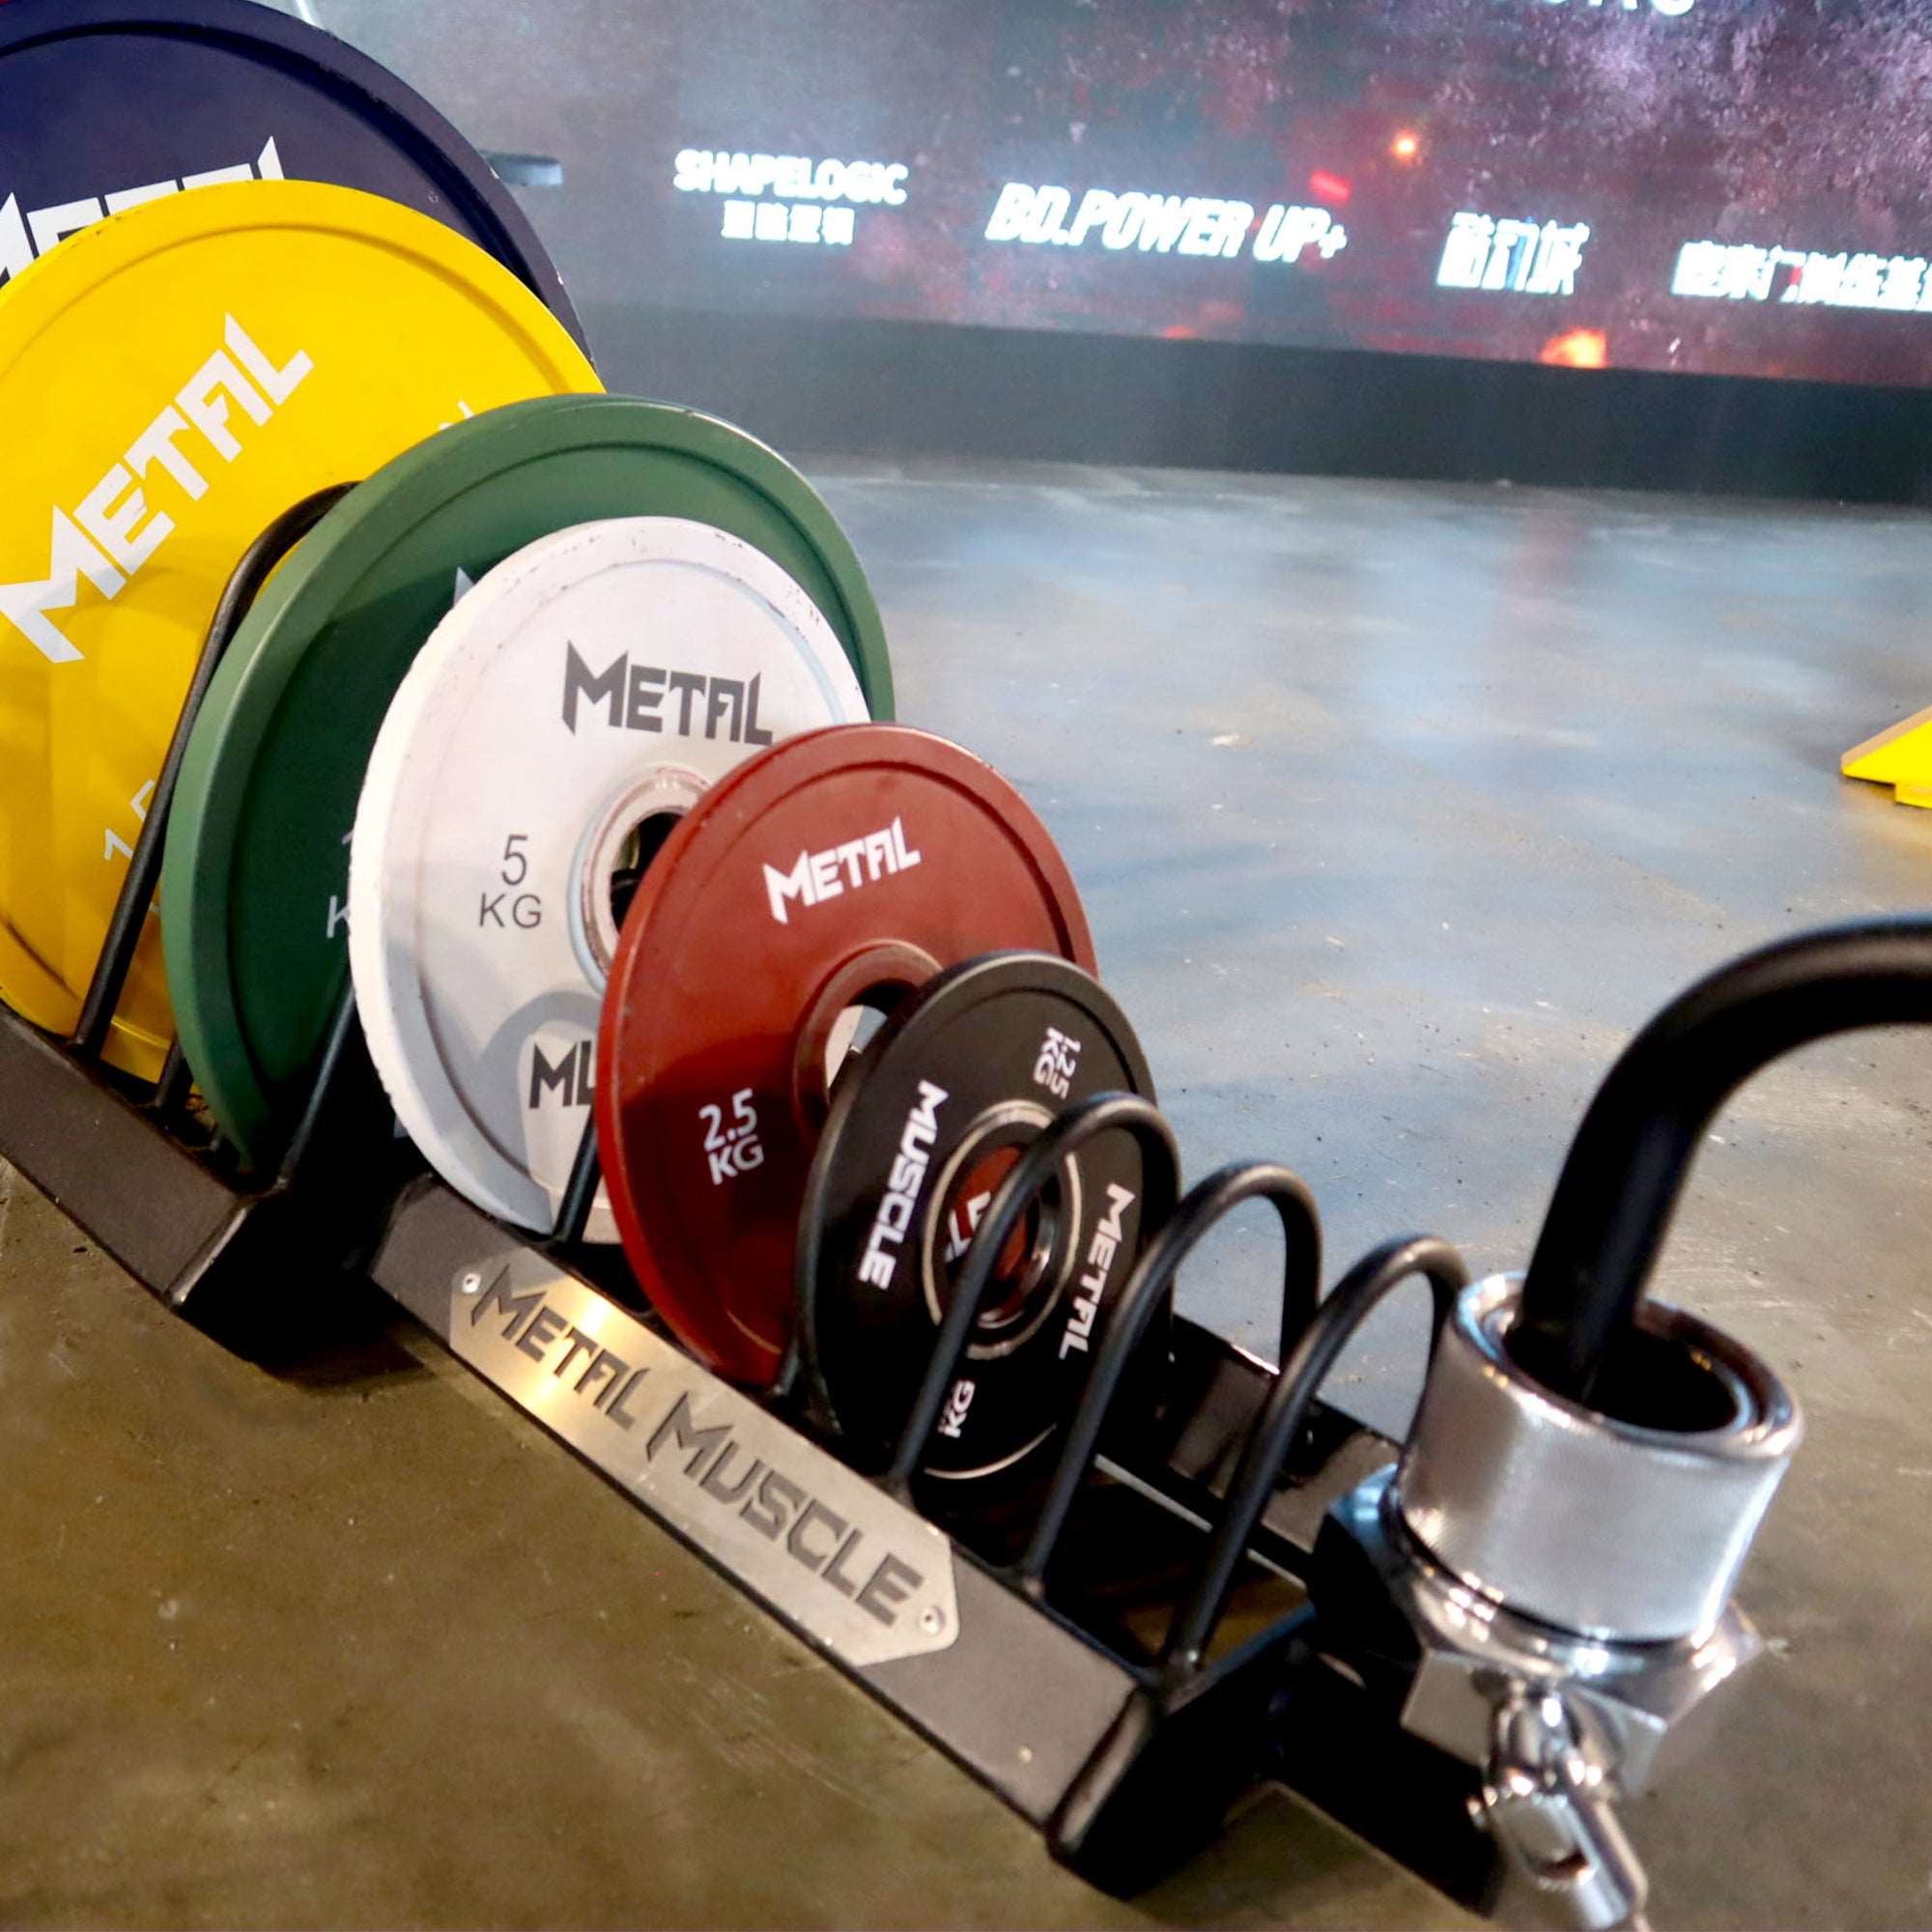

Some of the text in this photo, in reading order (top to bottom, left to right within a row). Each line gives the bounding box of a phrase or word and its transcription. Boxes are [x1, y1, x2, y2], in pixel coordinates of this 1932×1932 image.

[1252, 205, 1348, 263] UP+
[0, 311, 314, 663] METAL
[562, 639, 772, 746] METAL
[502, 834, 528, 886] 5
[762, 816, 922, 923] METAL
[479, 893, 542, 929] KG
[1034, 1027, 1063, 1085] KG
[699, 1088, 757, 1151] 2.5
[708, 1137, 764, 1185] KG
[858, 1079, 949, 1292] MUSCLE
[1059, 1182, 1136, 1359] METAL
[470, 1264, 924, 1627] METAL MUSCLE
